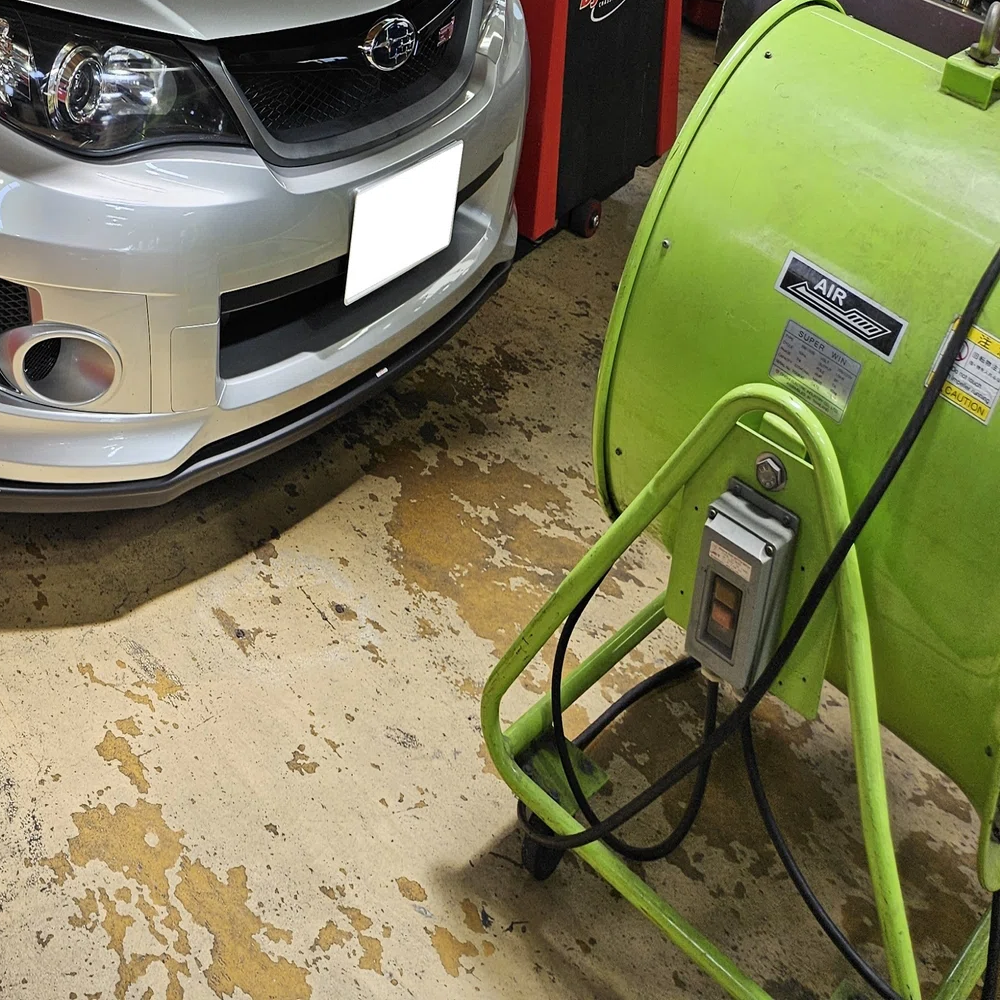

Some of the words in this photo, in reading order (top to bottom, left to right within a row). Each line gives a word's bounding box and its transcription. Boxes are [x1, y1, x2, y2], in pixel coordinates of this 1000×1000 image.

[813, 279, 847, 306] AIR
[798, 330, 825, 351] SUPER
[831, 351, 847, 366] WIN
[944, 385, 985, 416] CAUTION
